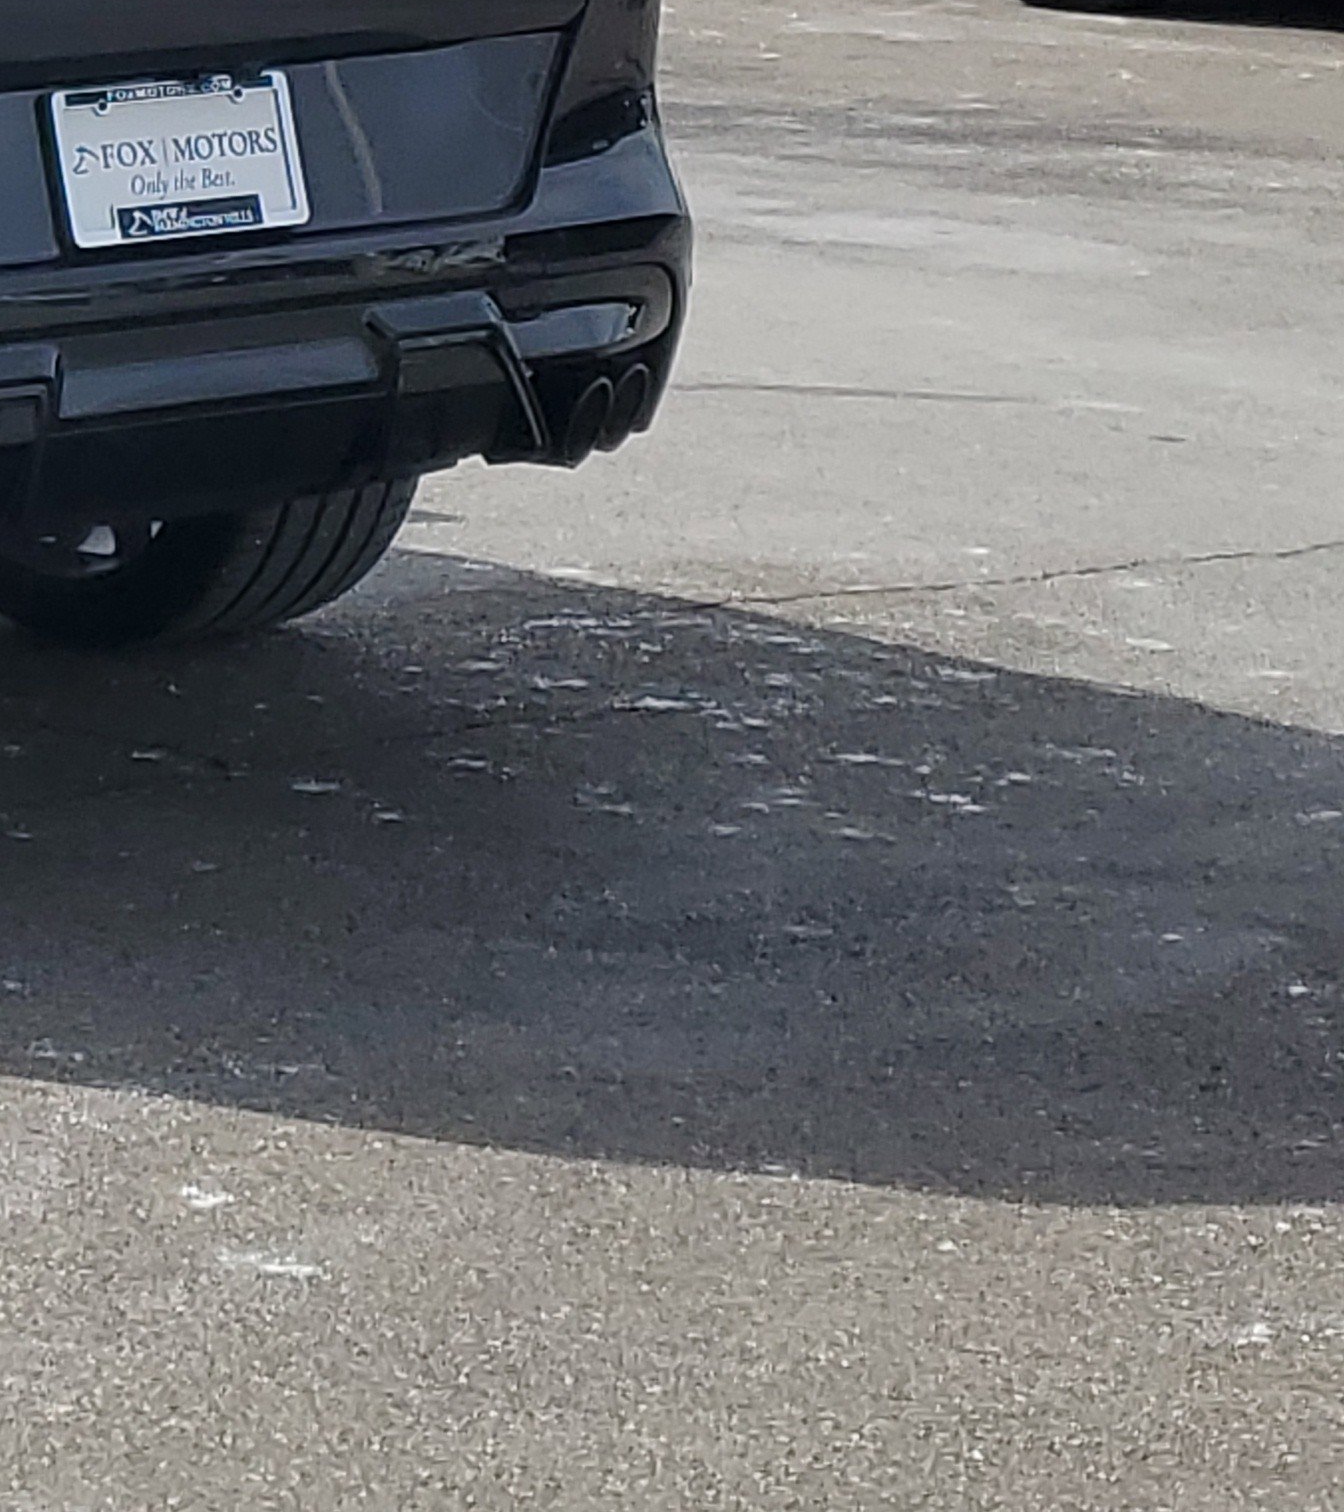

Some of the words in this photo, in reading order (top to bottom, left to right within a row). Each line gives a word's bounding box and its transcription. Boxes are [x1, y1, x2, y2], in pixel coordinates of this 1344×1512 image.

[100, 140, 158, 169] FOX
[172, 127, 278, 163] MOTORS
[130, 170, 170, 199] Only
[174, 169, 196, 191] the
[202, 168, 236, 189] Best.
